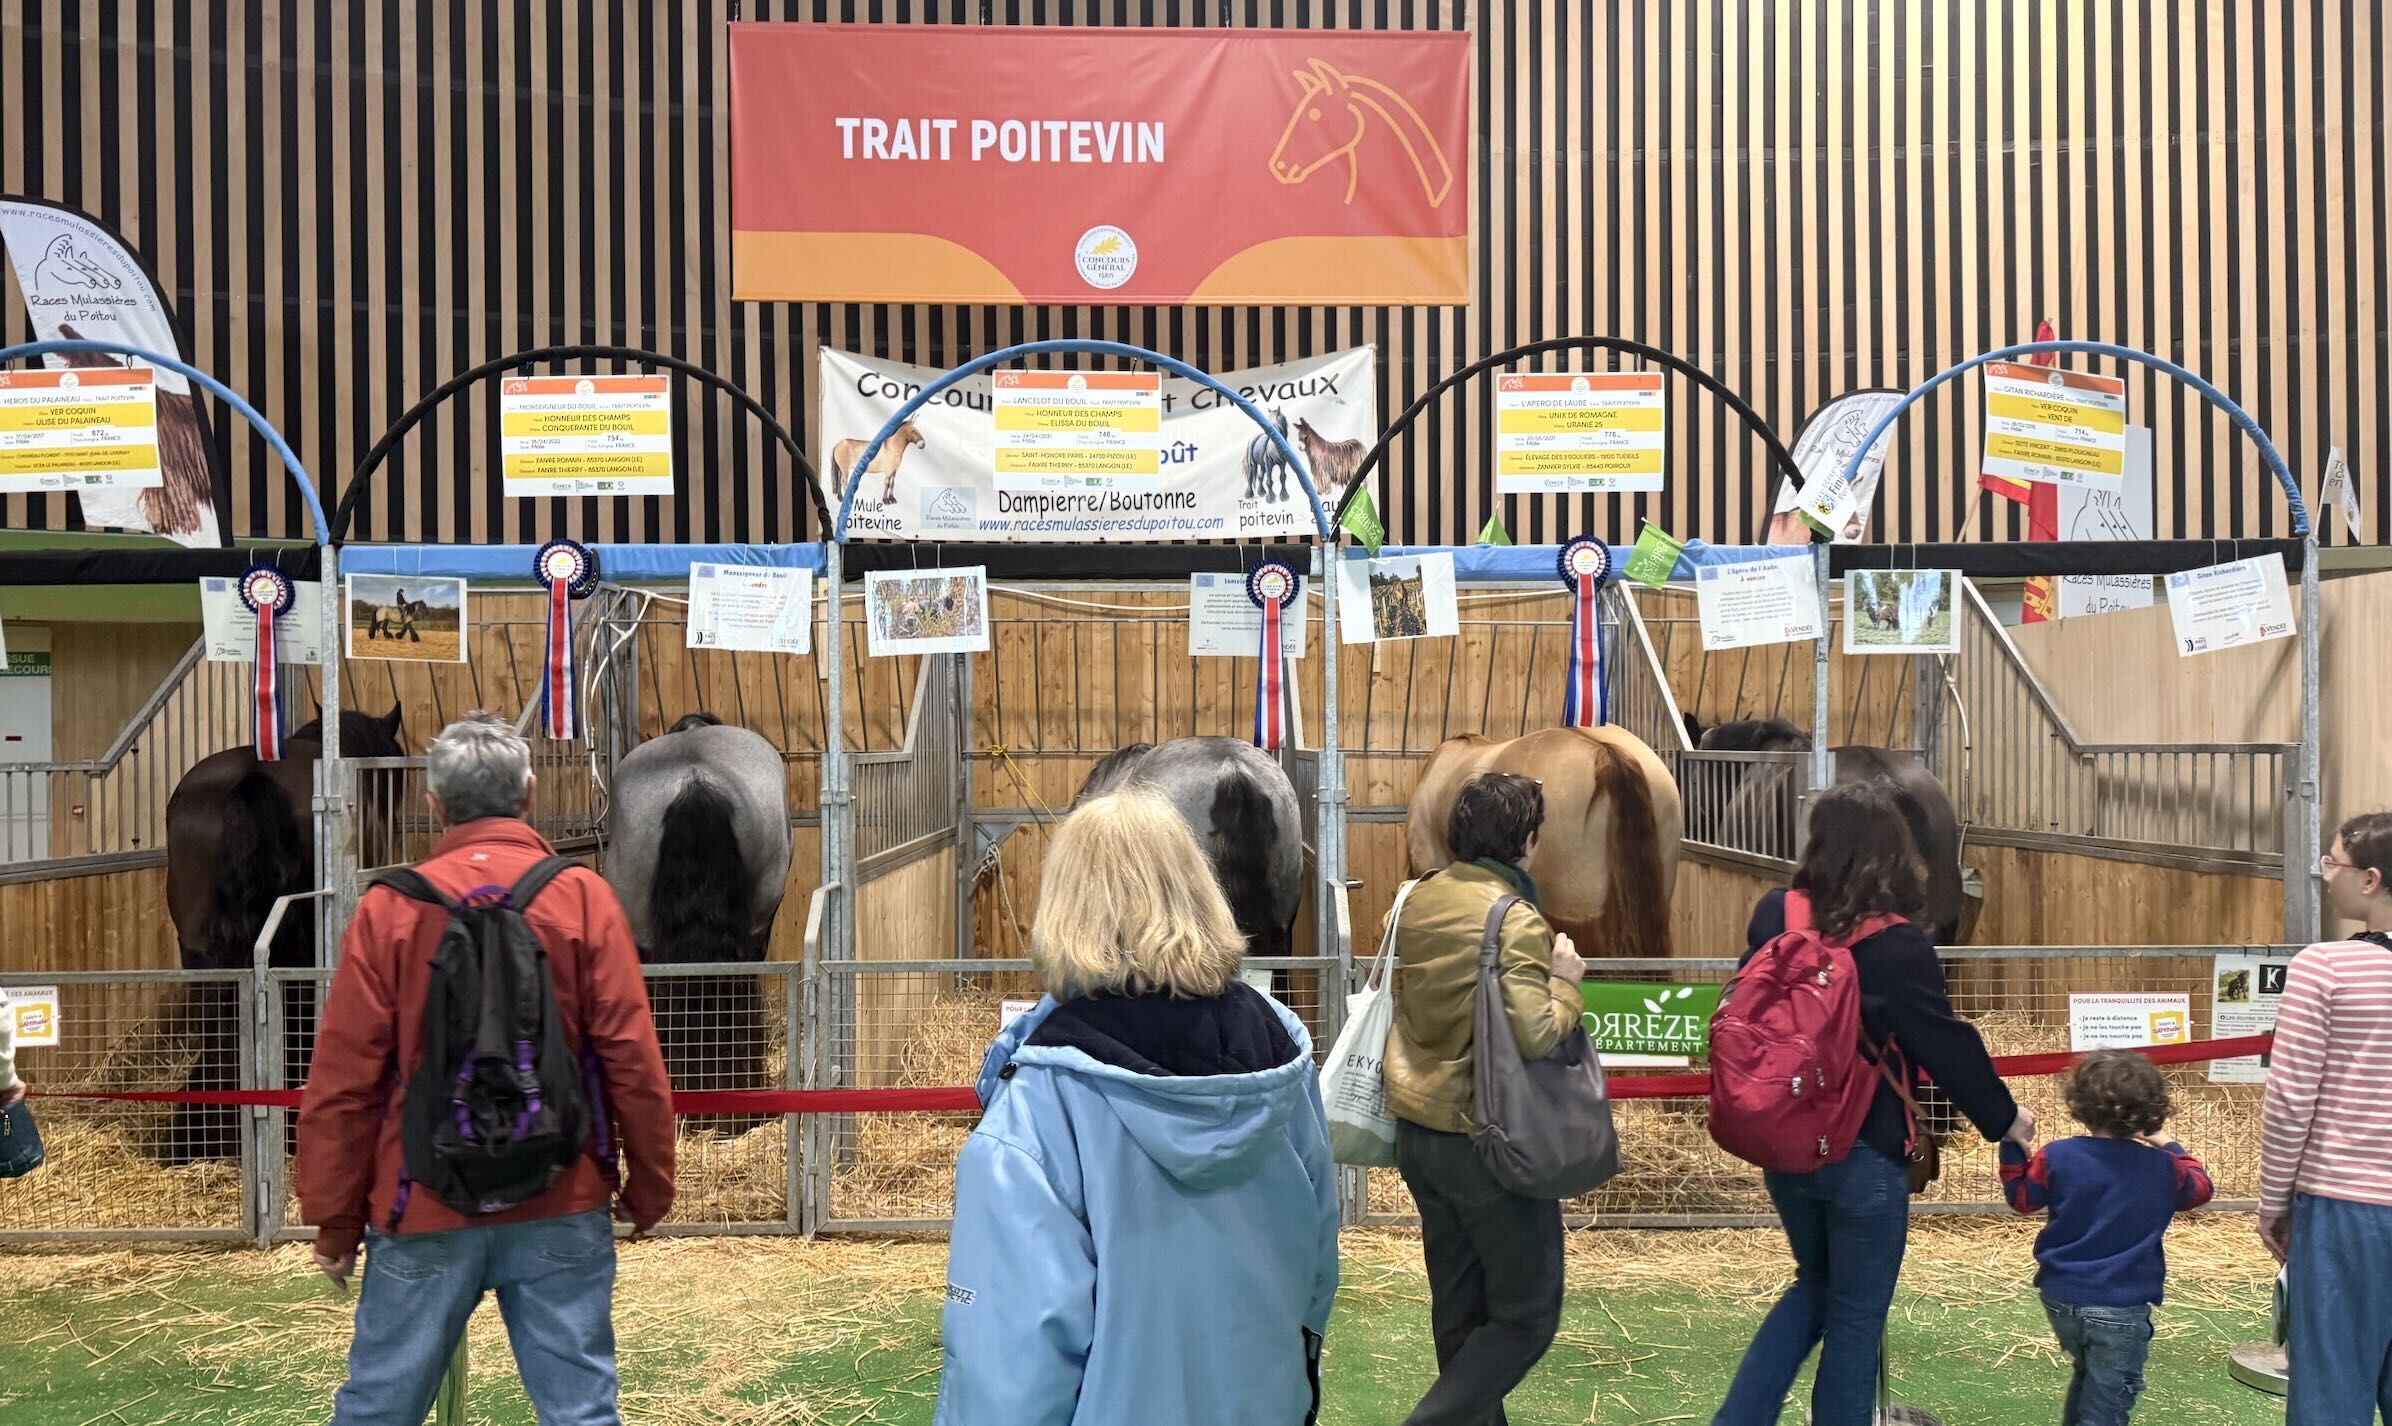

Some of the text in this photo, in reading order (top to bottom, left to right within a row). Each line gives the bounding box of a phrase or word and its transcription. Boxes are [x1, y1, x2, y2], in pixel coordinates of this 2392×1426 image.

[835, 117, 1165, 163] TRAIT POITEVIN
[1082, 256, 1130, 264] CONCOURS
[1086, 263, 1126, 271] GÉNÉRAL
[30, 294, 137, 307] Races Mulassières
[64, 310, 117, 321] du Poitou
[2004, 385, 2024, 394] GITAN
[1013, 397, 1052, 405] LANCELOT
[50, 407, 96, 416] VER COQUIN
[2052, 404, 2078, 414] COQUIN
[36, 418, 56, 426] ULISE
[70, 416, 111, 425] PALAINEAU
[2048, 413, 2073, 423] VENT DE
[542, 424, 599, 432] CONQUERANTE
[612, 423, 635, 431] BOUIL
[854, 498, 884, 513] Mule
[1238, 500, 1258, 510] Trait
[846, 513, 902, 531] oitevine
[979, 515, 1224, 535] www.racesmulassieresdupoitou.com
[1240, 510, 1294, 531] poitevin
[2085, 596, 2097, 614] du
[2265, 966, 2282, 989] K
[1594, 1036, 1703, 1053] ÉPARTEMENT
